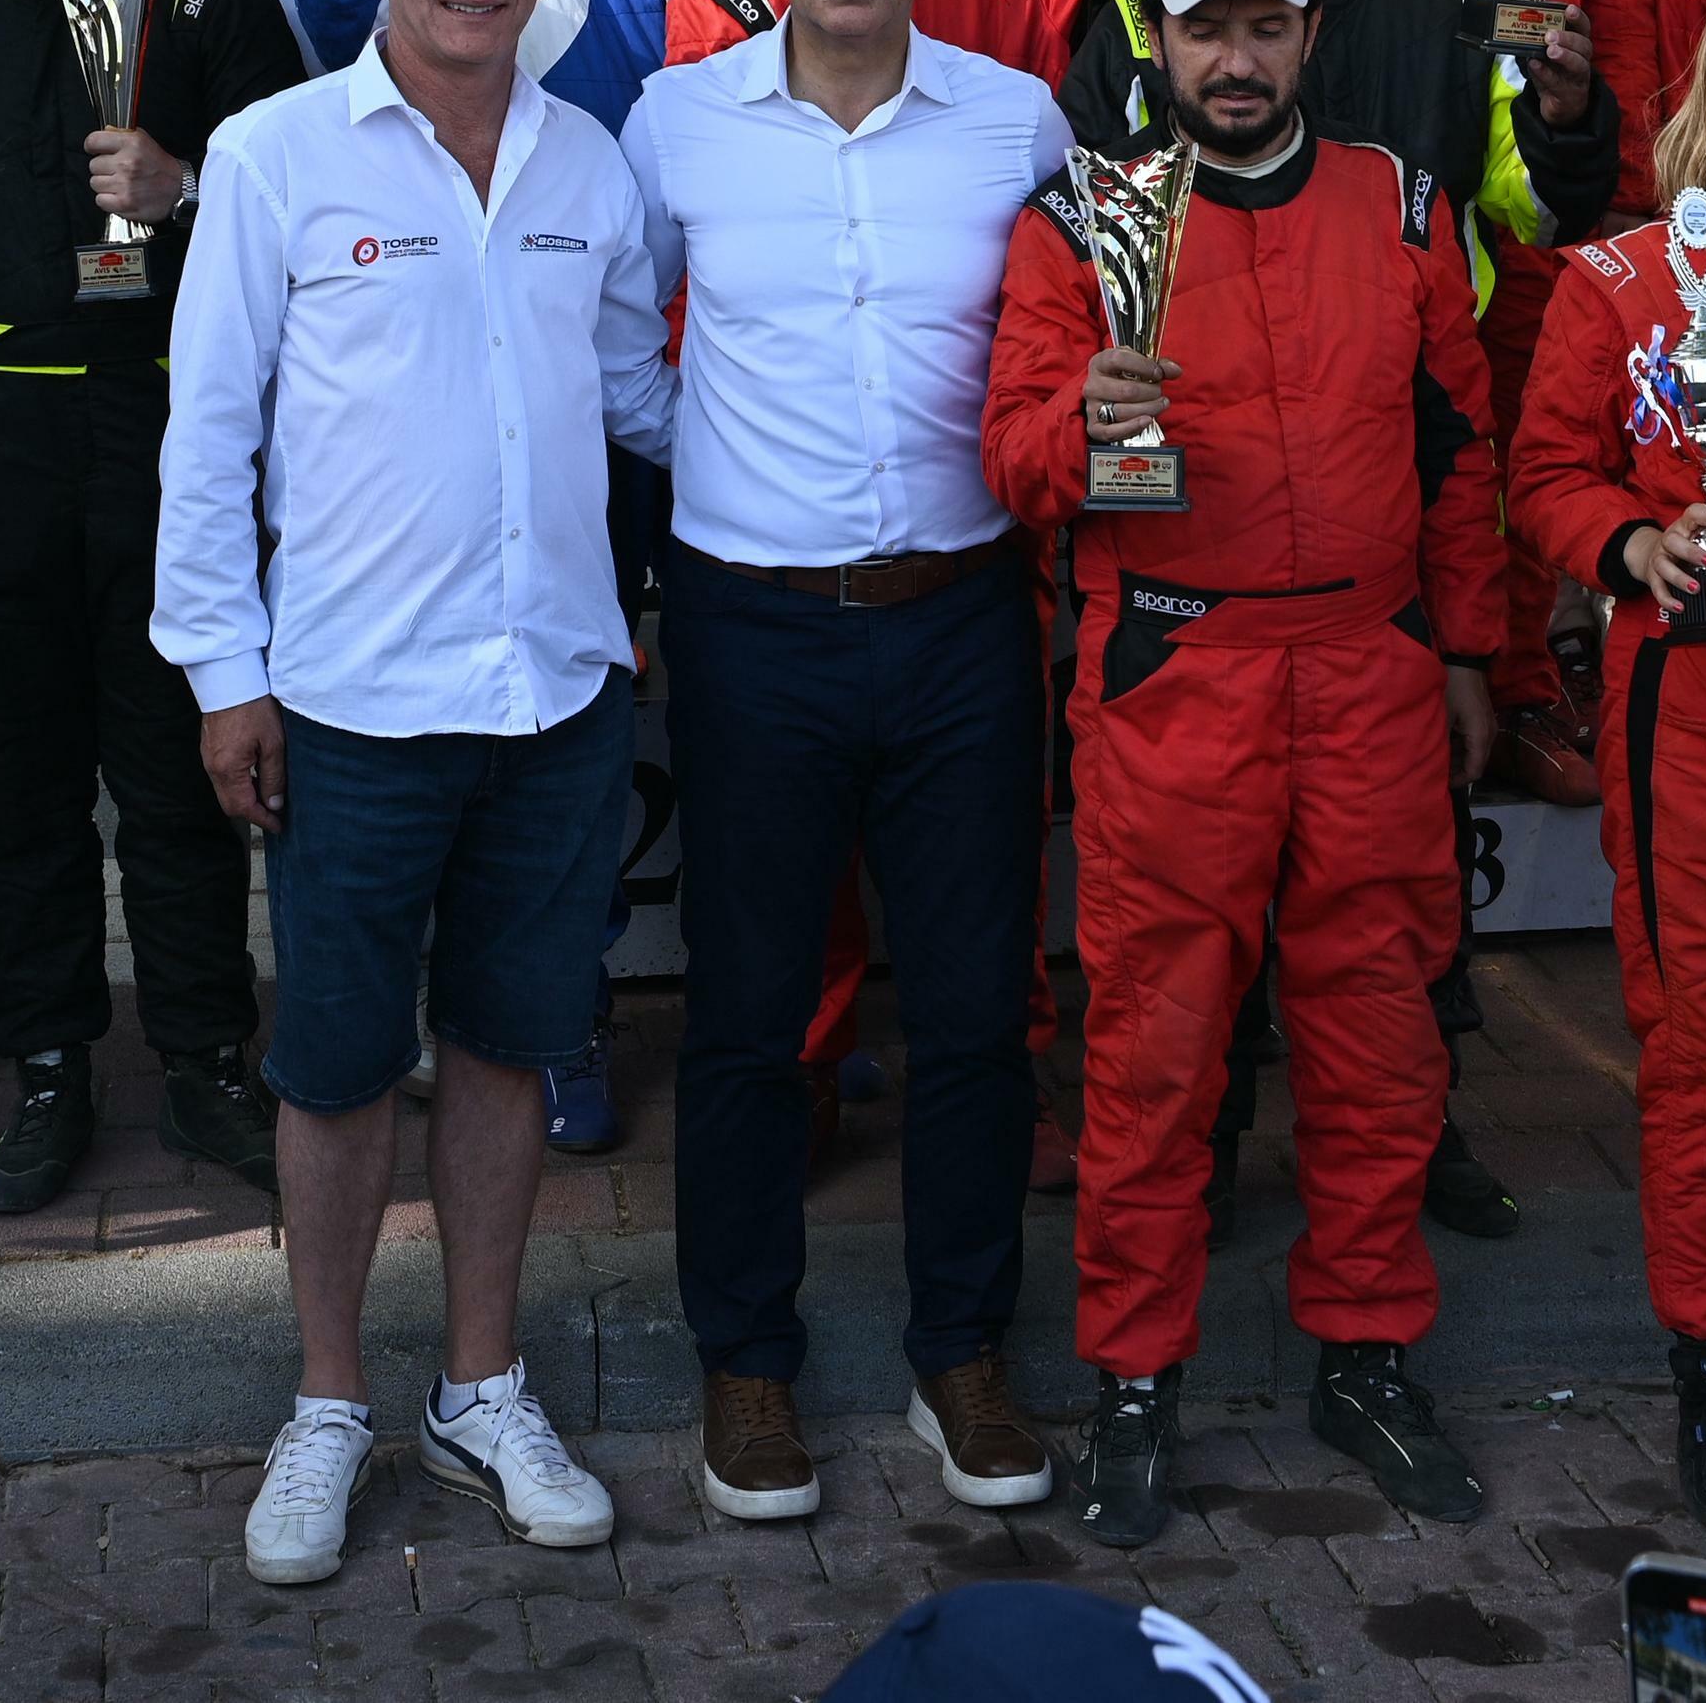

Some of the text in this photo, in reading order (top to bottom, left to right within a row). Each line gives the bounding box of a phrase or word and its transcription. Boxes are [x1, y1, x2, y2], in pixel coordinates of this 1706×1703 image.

[1413, 169, 1432, 235] sparco
[382, 237, 438, 248] TOSFED
[538, 237, 584, 249] BOSSEK
[1575, 244, 1623, 277] sparco
[1111, 472, 1132, 480] AVIS
[1133, 589, 1206, 618] sparco
